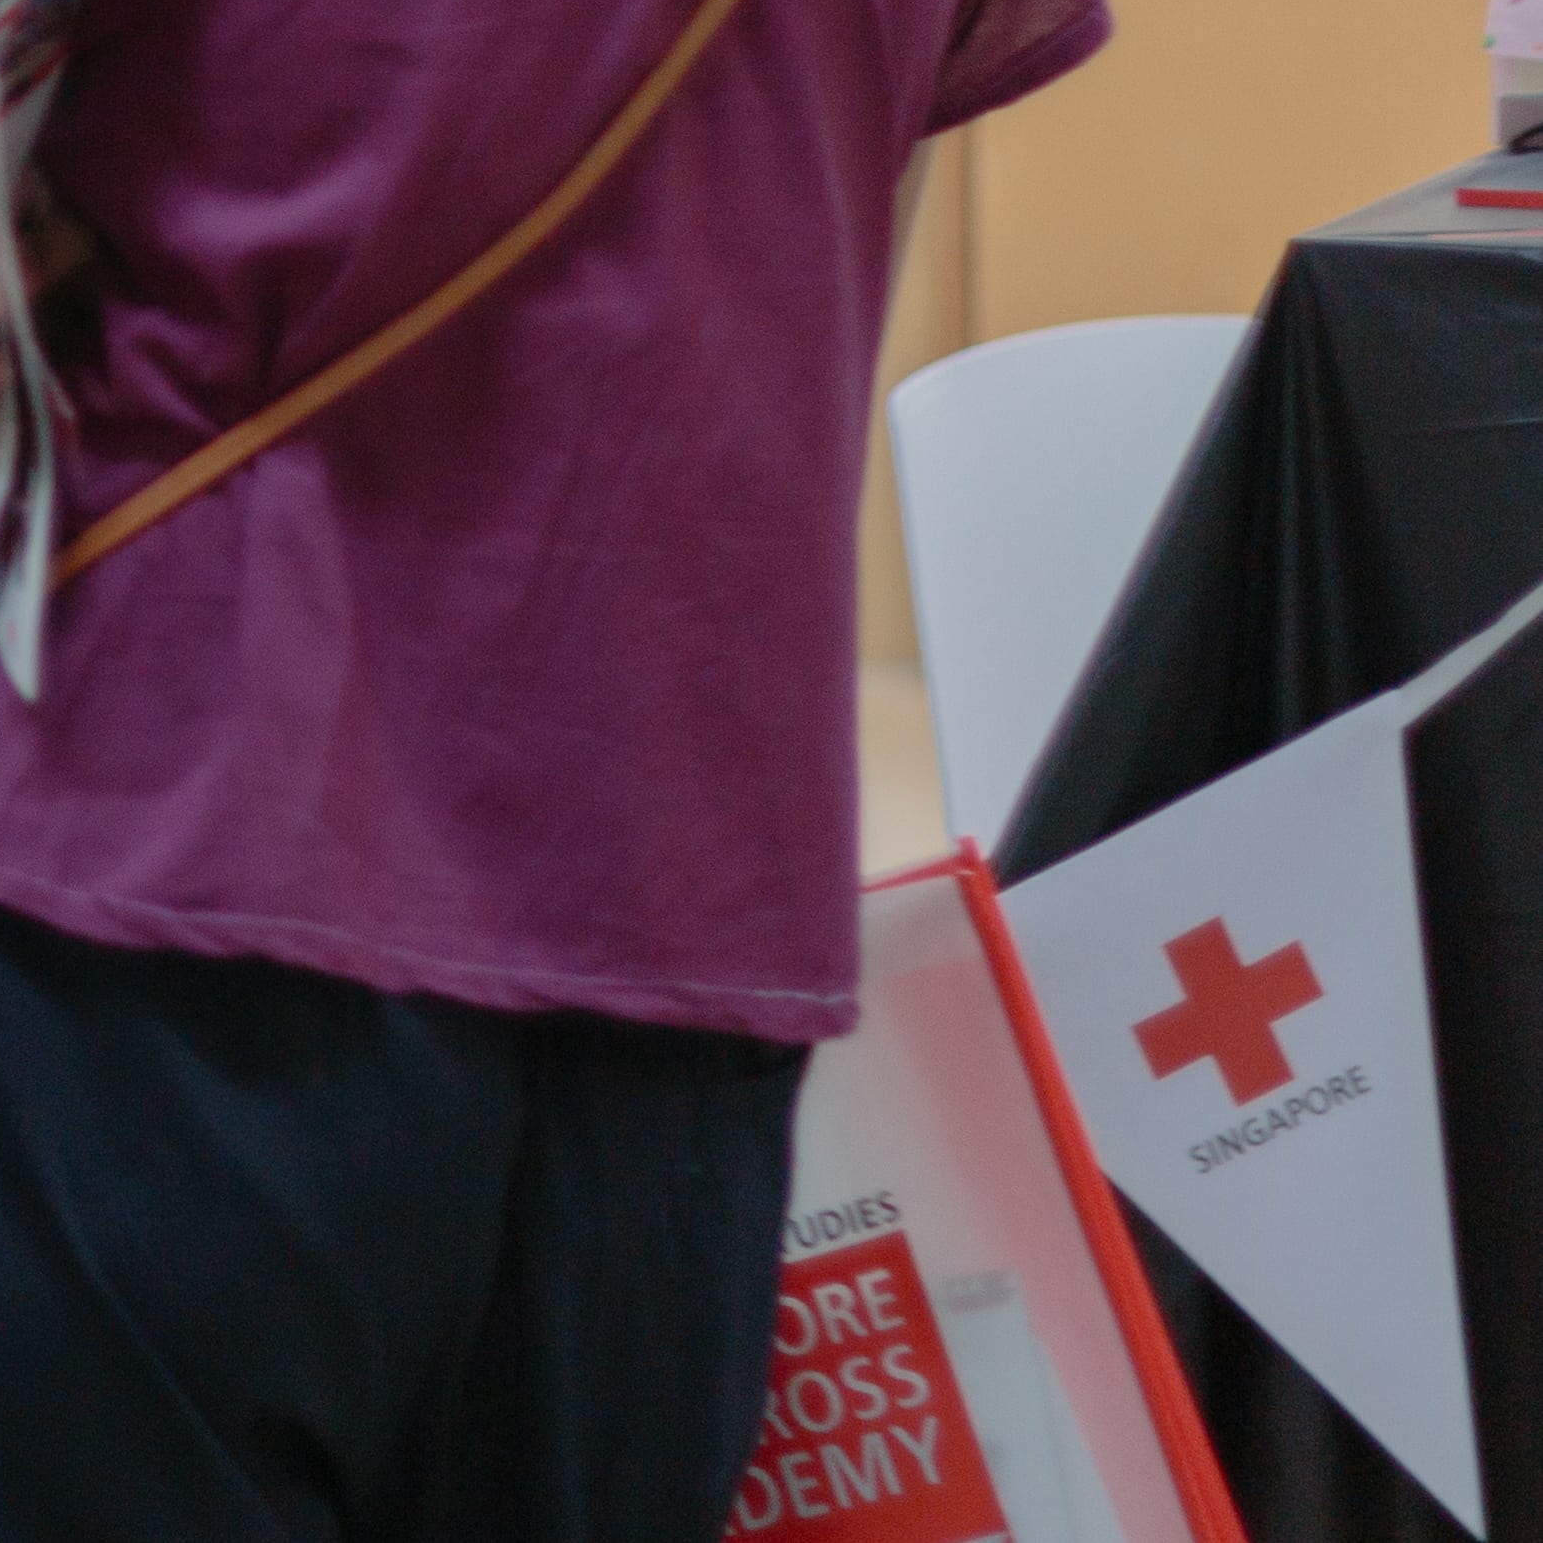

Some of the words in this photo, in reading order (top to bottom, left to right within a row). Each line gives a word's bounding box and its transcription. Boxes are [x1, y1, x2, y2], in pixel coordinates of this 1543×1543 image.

[1188, 1064, 1373, 1174] SINGAPORE
[787, 1190, 901, 1249] UDIES
[725, 1414, 942, 1536] DEMY
